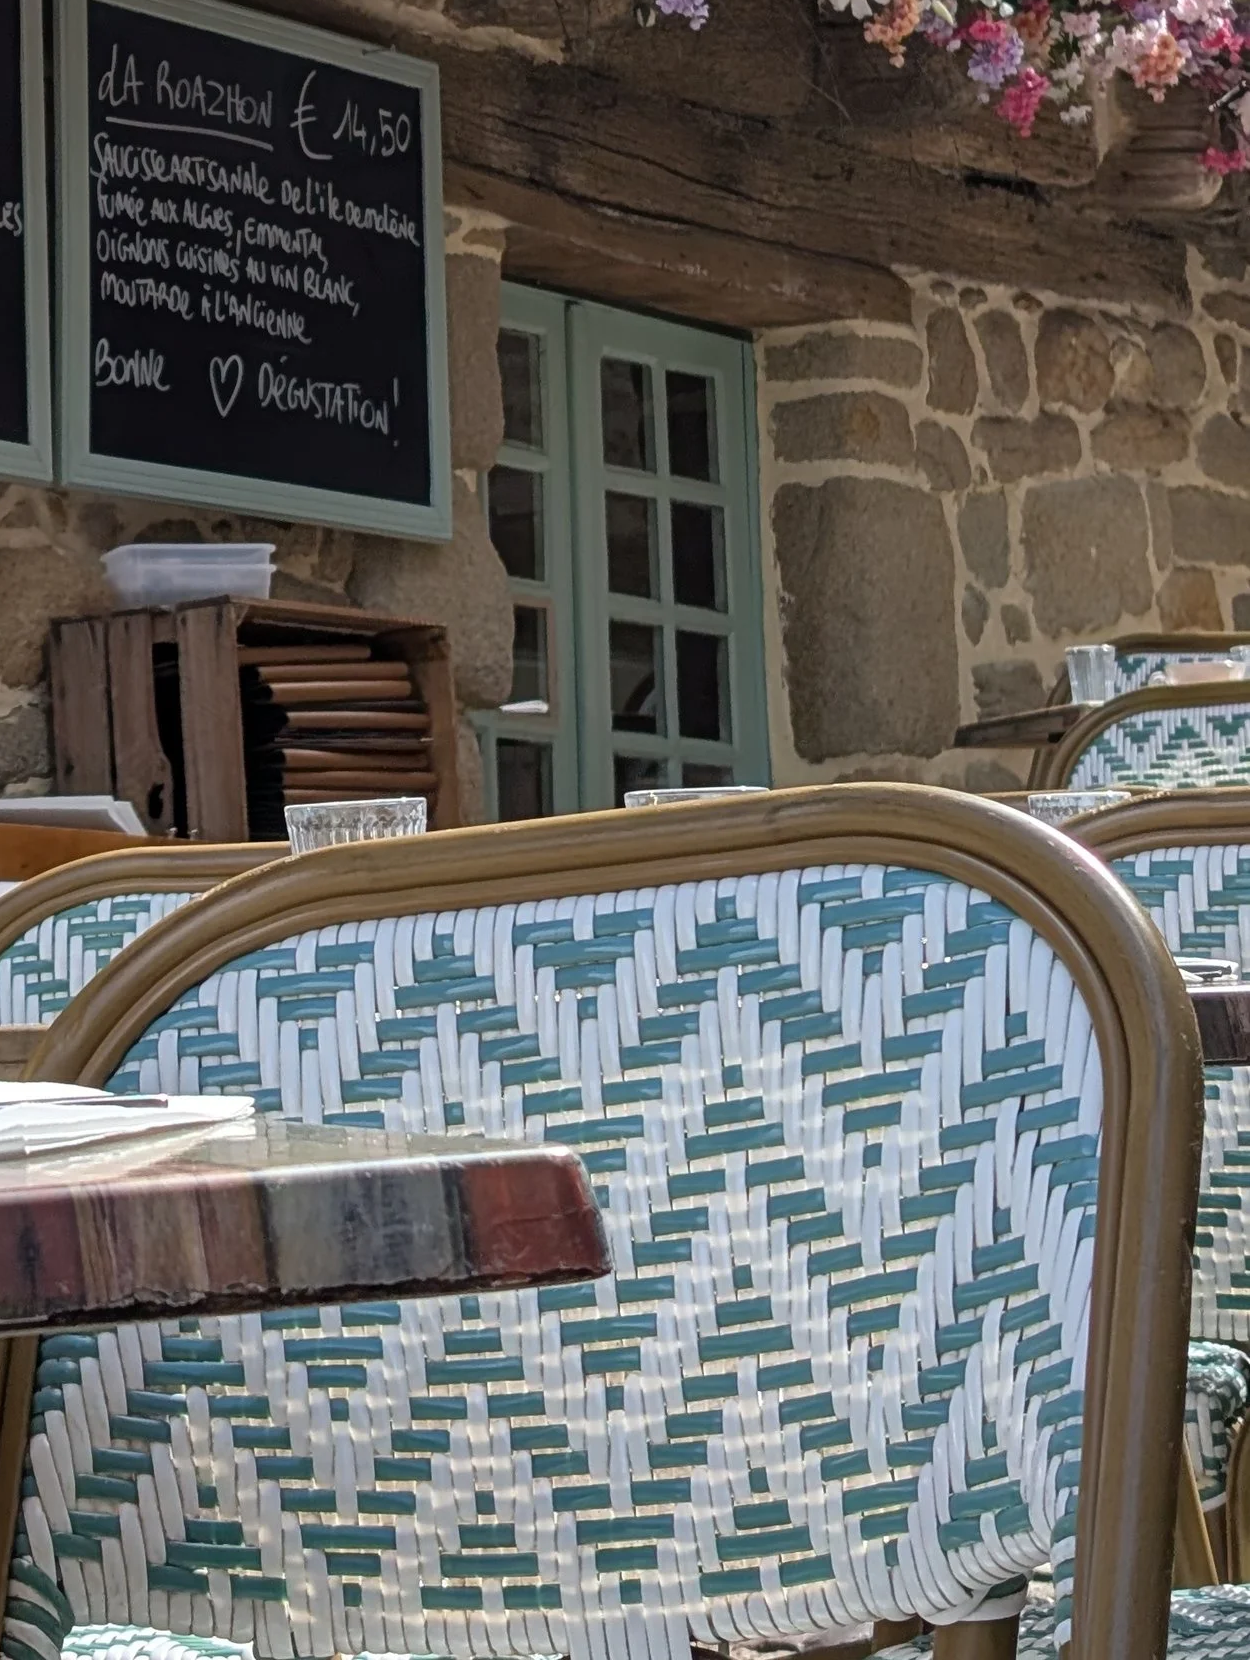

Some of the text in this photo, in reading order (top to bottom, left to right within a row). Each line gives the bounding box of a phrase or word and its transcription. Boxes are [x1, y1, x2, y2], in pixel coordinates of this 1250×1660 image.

[156, 60, 272, 128] ROAZHON
[290, 70, 333, 160] €
[333, 99, 411, 157] 14,50
